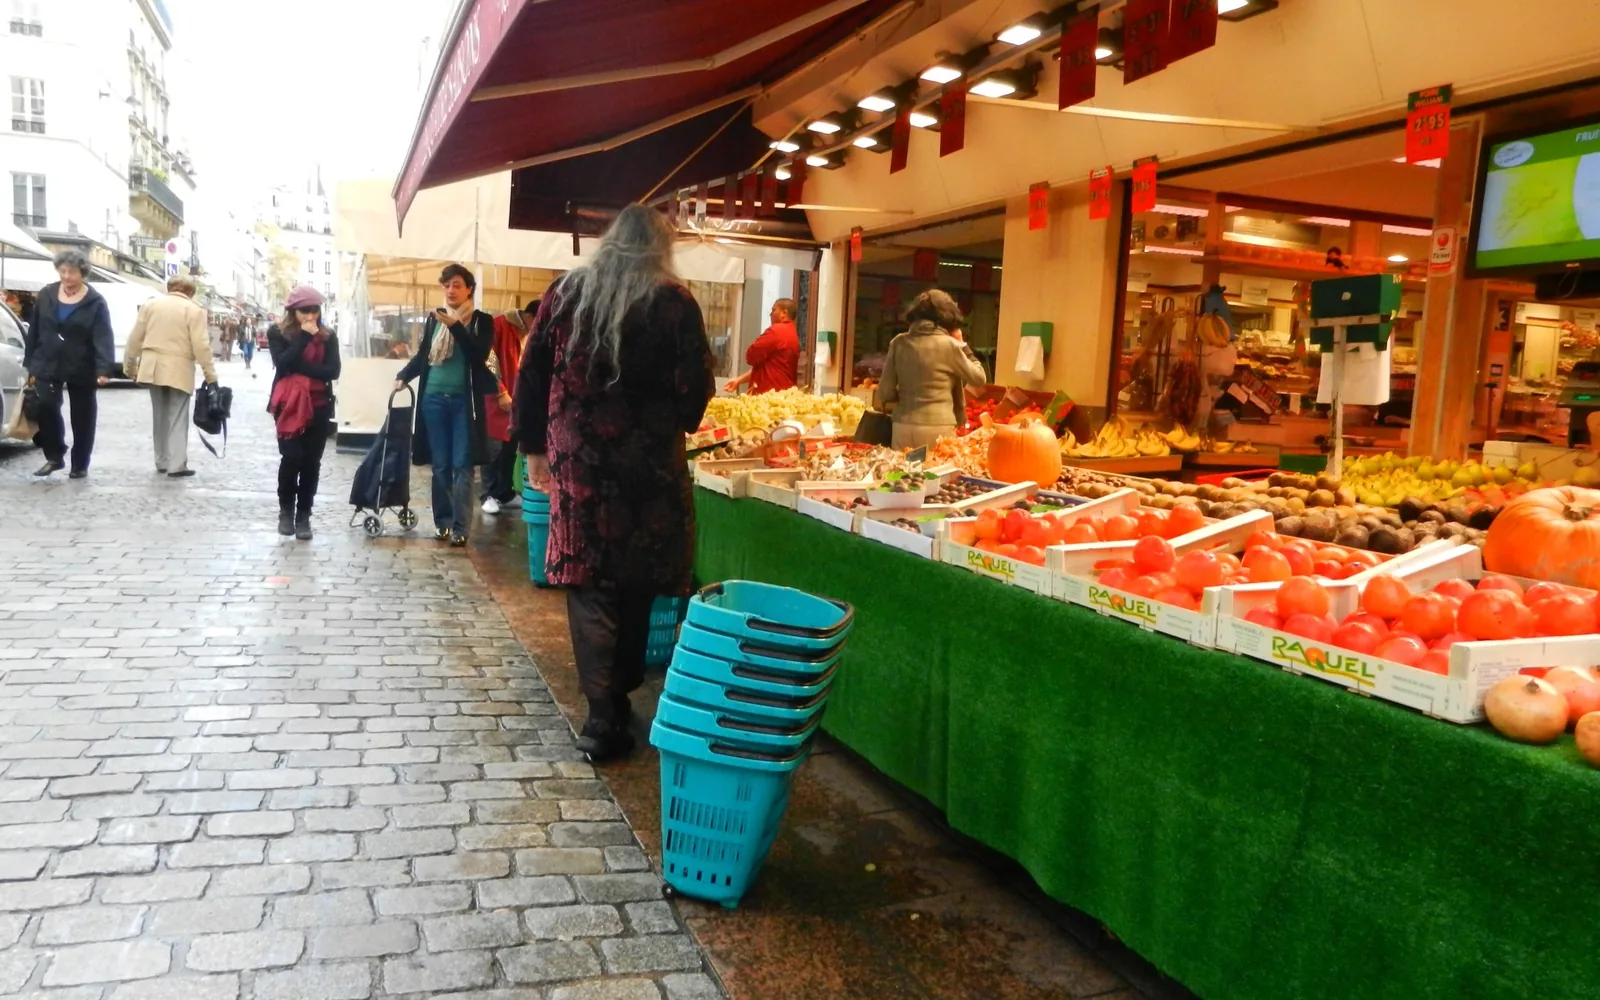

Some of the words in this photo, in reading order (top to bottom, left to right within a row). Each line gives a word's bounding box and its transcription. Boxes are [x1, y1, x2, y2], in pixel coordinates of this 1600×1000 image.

[967, 550, 1015, 574] RAQUEL
[1088, 586, 1157, 617] RAQUEL
[1272, 636, 1376, 678] RAQUEL
